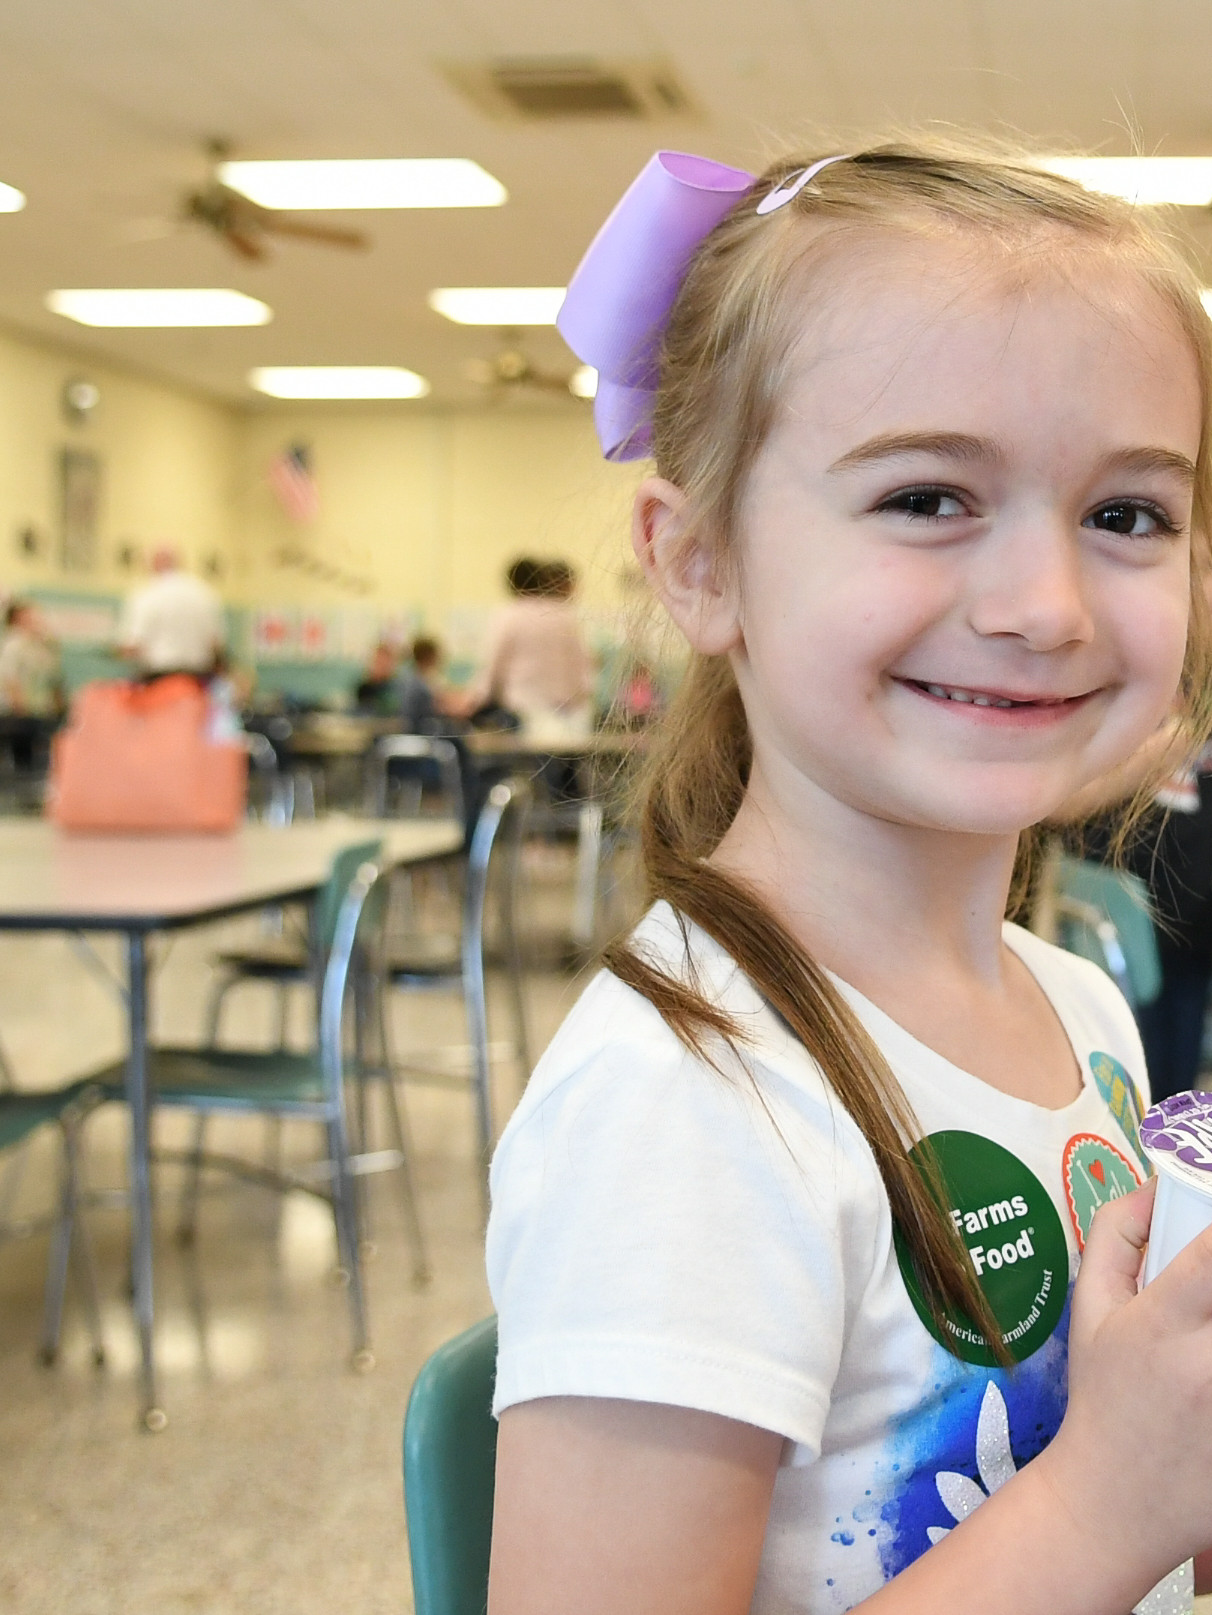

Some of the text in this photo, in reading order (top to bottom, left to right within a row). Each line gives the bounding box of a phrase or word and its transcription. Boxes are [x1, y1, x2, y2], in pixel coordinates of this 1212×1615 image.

[949, 1195, 1029, 1238] Farms
[941, 1269, 1053, 1346] merica armland Trust
